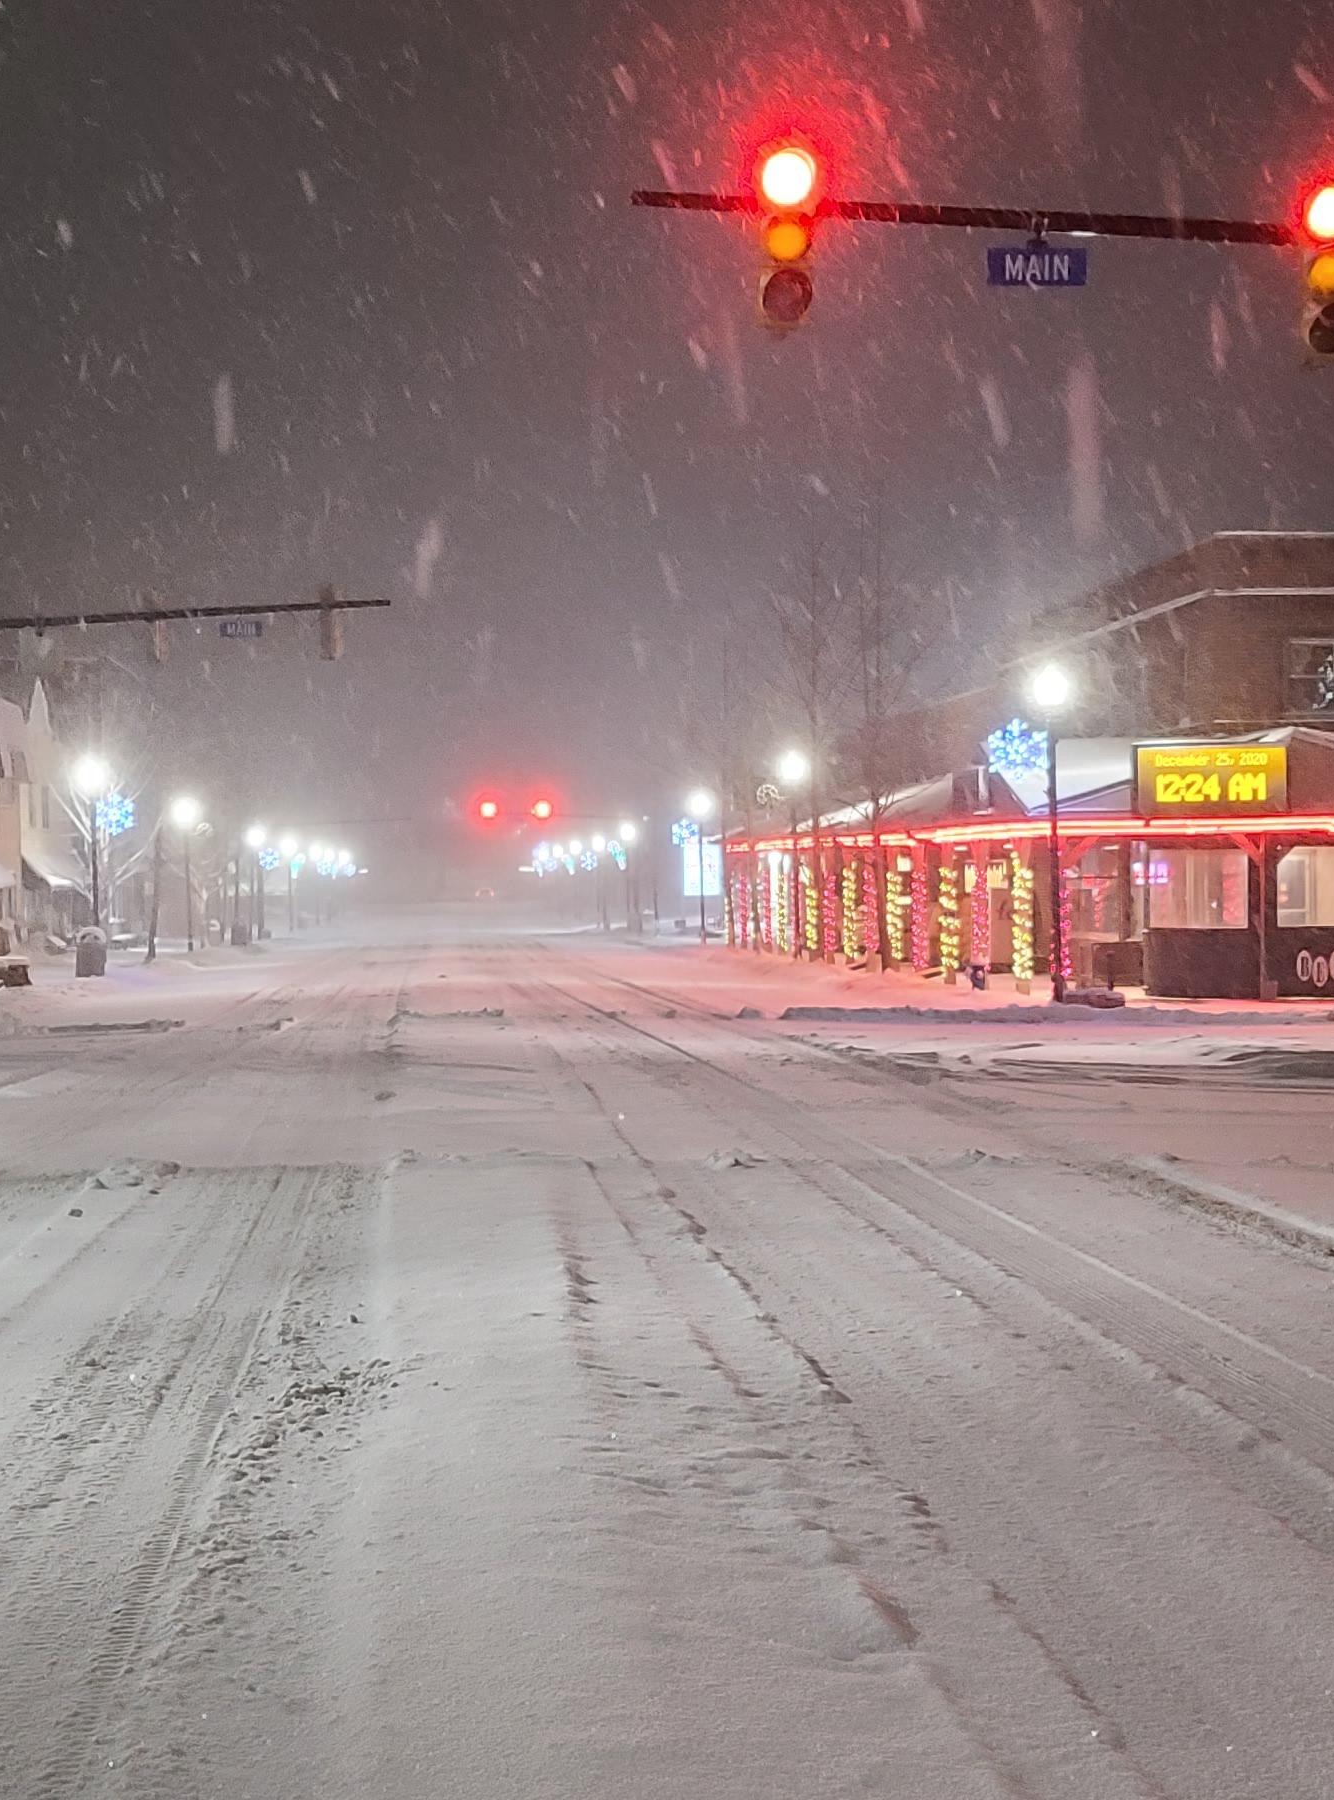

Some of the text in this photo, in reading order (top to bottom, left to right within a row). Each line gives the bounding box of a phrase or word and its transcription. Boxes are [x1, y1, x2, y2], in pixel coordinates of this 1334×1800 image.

[1005, 253, 1069, 281] MAIN
[226, 623, 256, 635] MAIN
[1155, 754, 1210, 767] December
[1239, 753, 1268, 766] 2020
[1155, 772, 1267, 803] 12:24 AM
